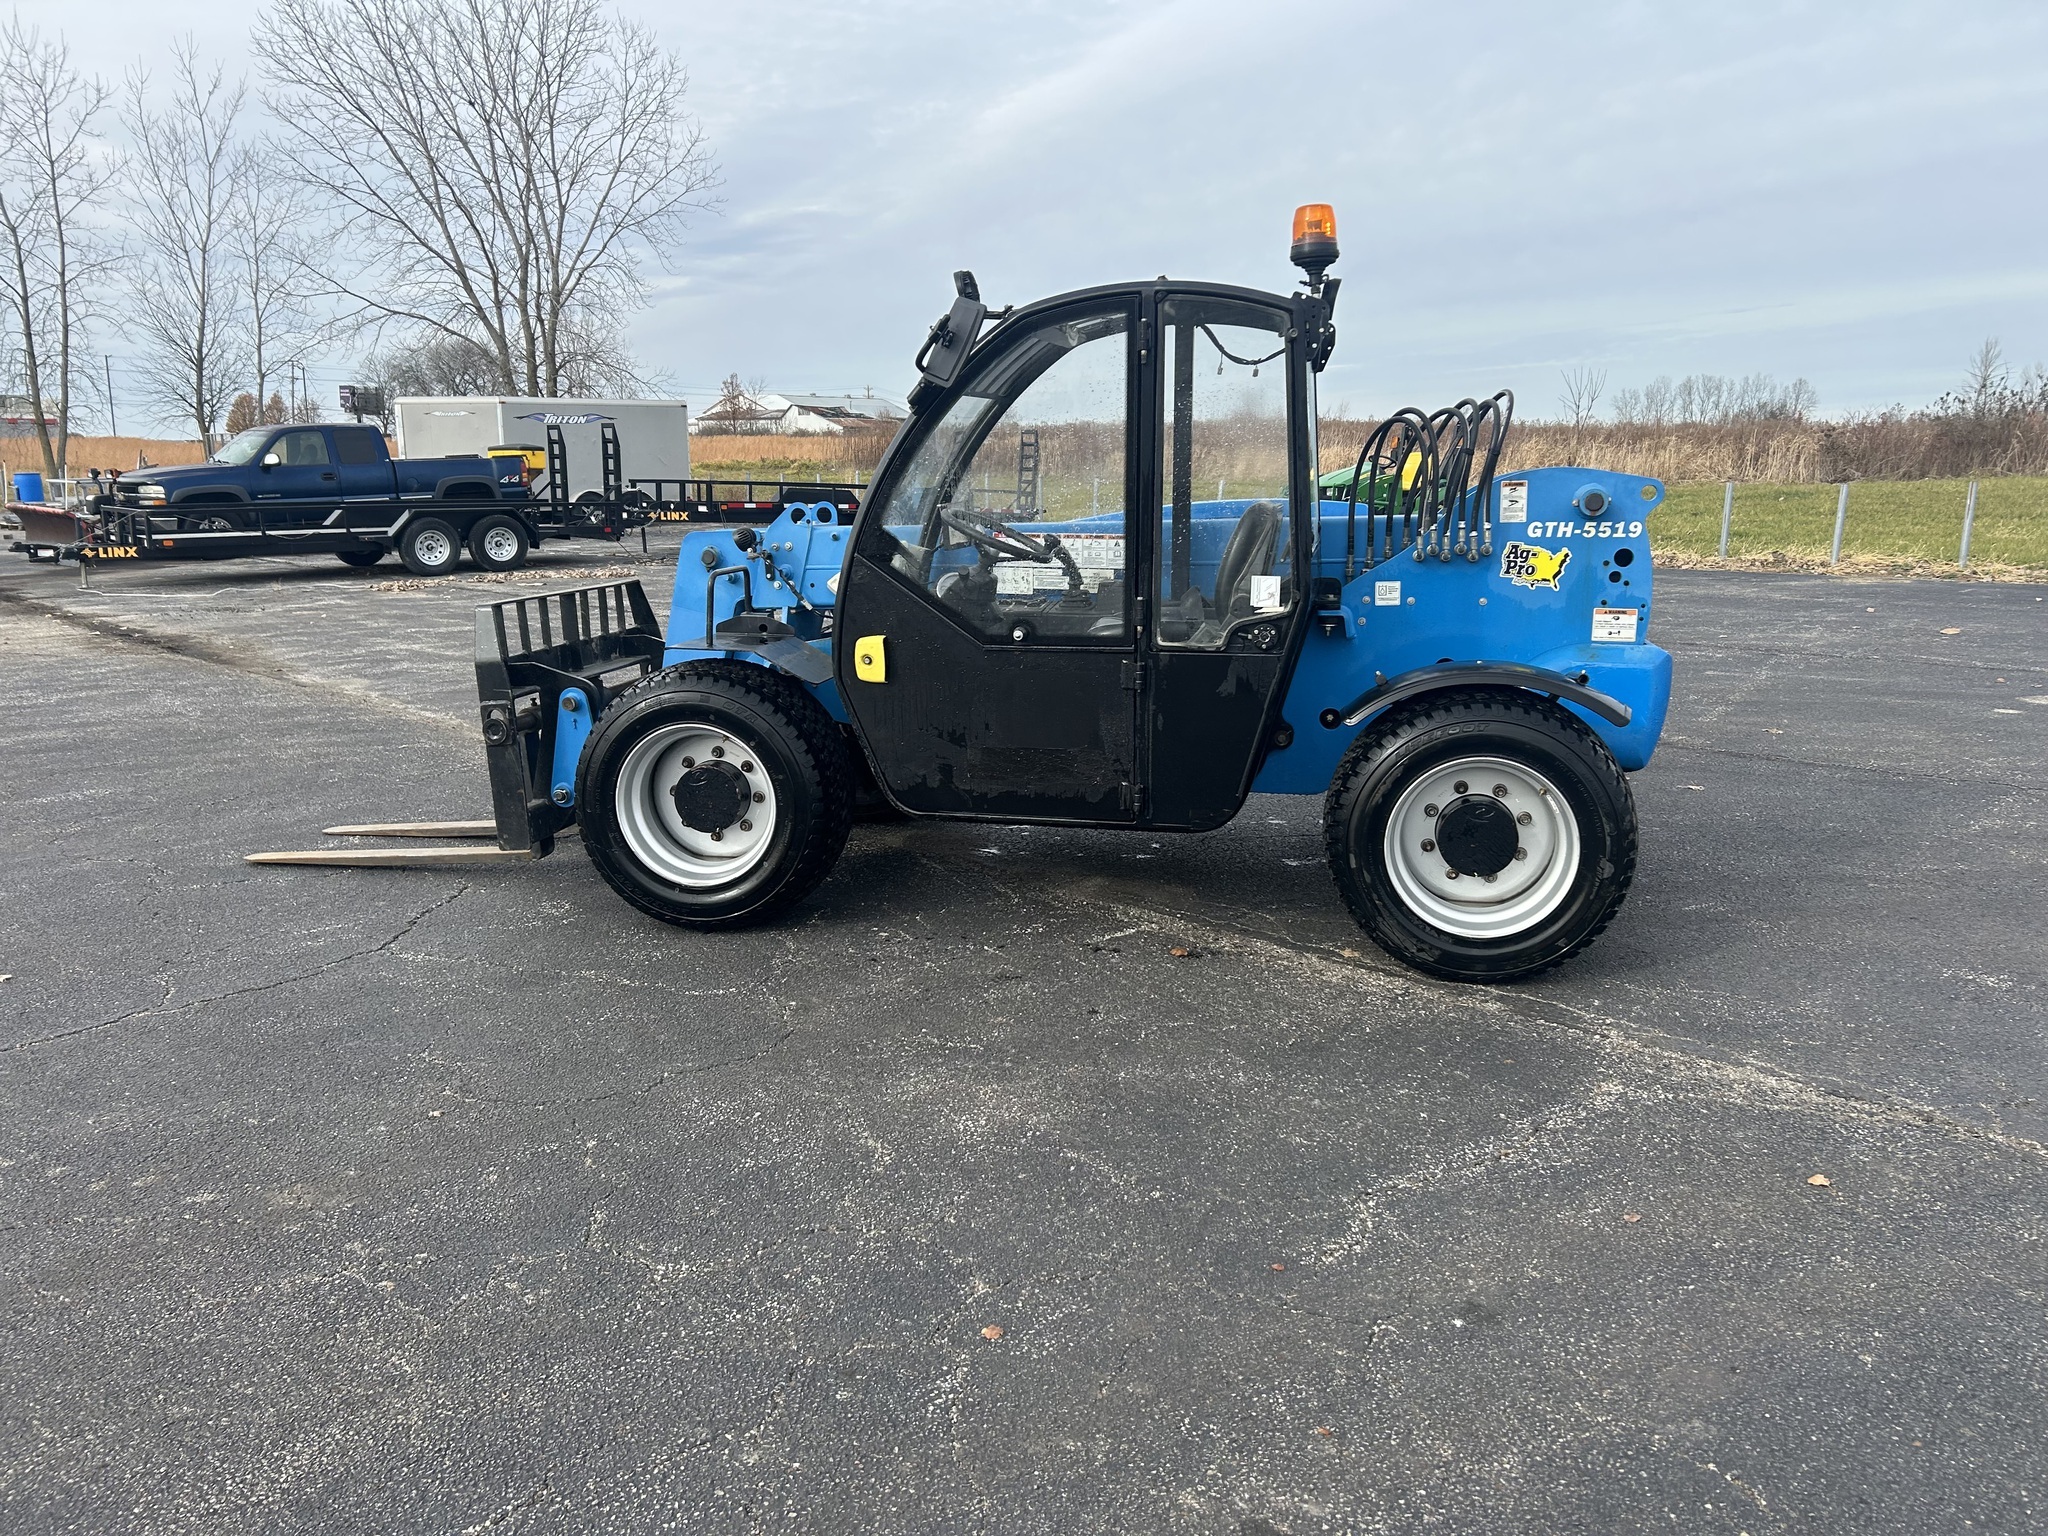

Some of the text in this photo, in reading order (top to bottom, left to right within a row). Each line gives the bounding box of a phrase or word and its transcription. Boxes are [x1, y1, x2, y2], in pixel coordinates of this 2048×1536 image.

[543, 413, 588, 424] TRITON
[660, 511, 689, 521] LINX
[1527, 521, 1643, 538] GTH-5519
[98, 546, 139, 558] LINX
[1505, 544, 1538, 564] Ag-
[1503, 560, 1536, 576] Pro
